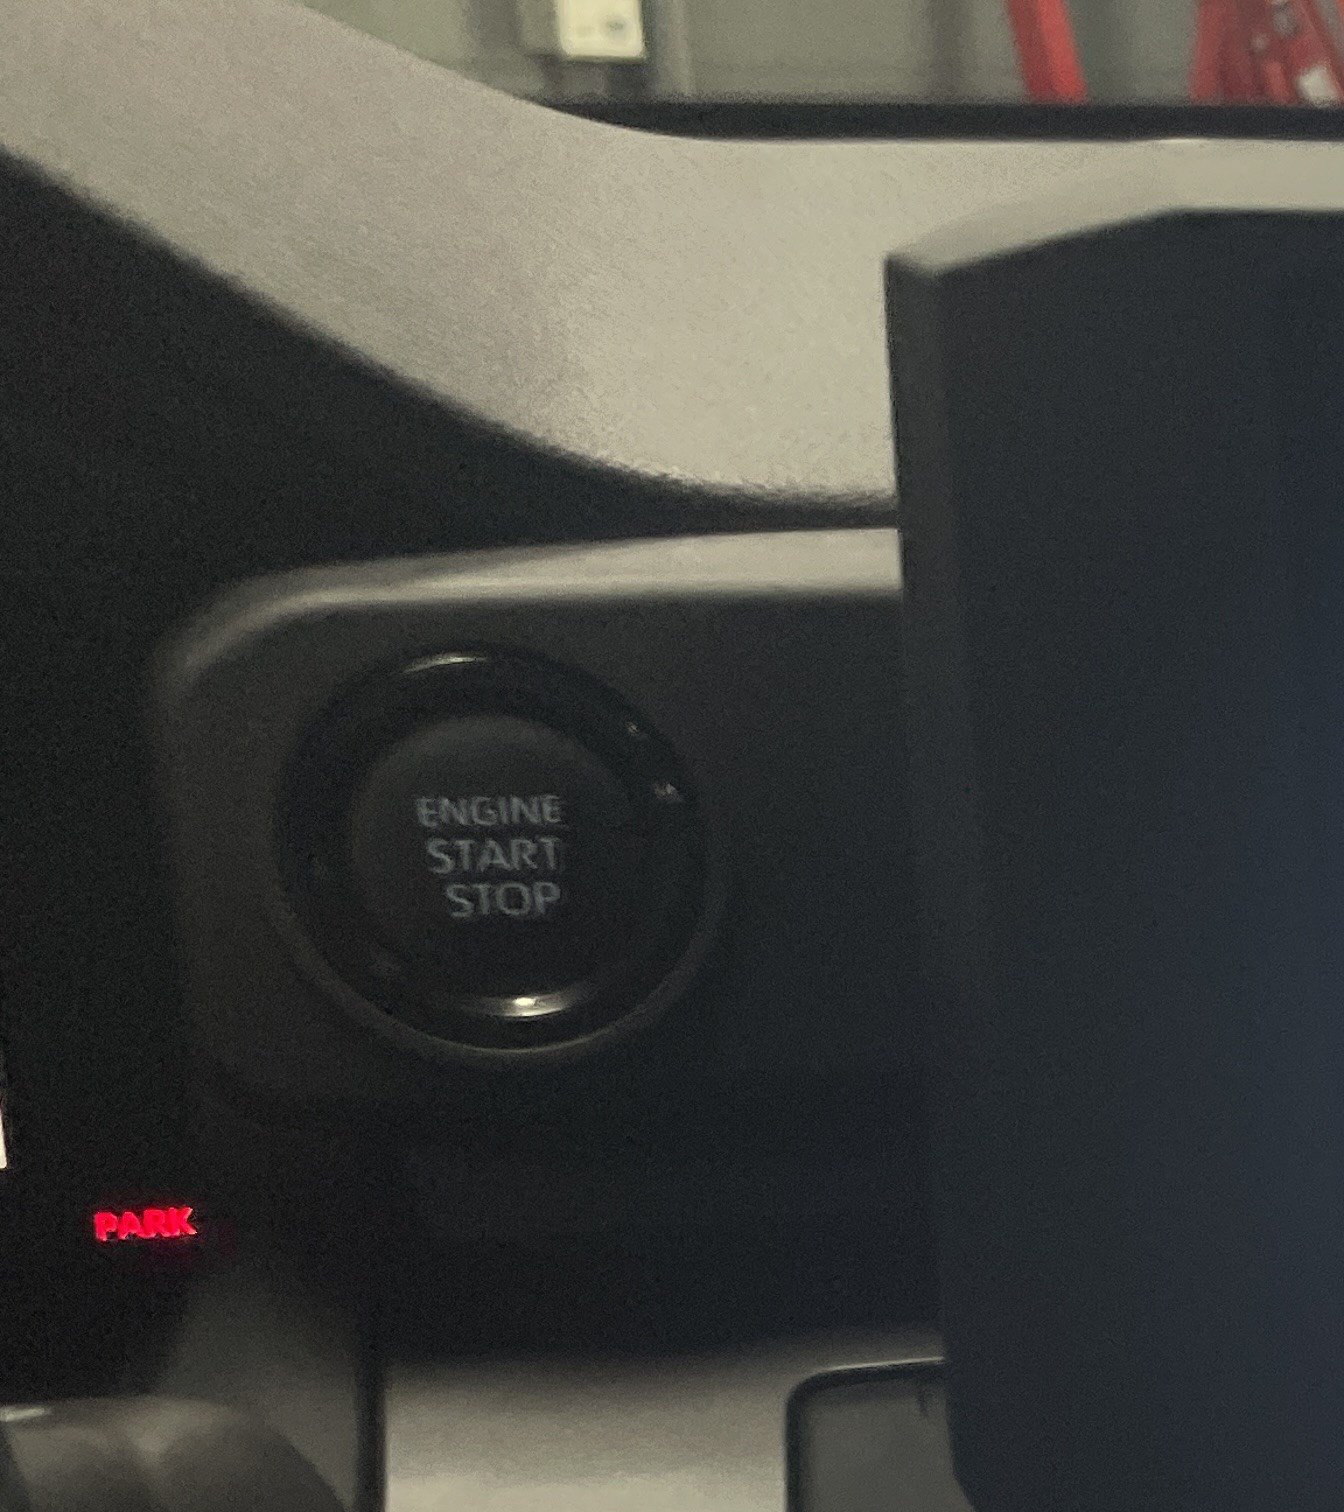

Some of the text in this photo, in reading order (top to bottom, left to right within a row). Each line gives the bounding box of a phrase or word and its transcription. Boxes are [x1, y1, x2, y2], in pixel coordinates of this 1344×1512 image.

[417, 795, 563, 828] ENGINE
[427, 837, 560, 874] START
[446, 881, 561, 918] STOP
[94, 1207, 197, 1241] PARK
